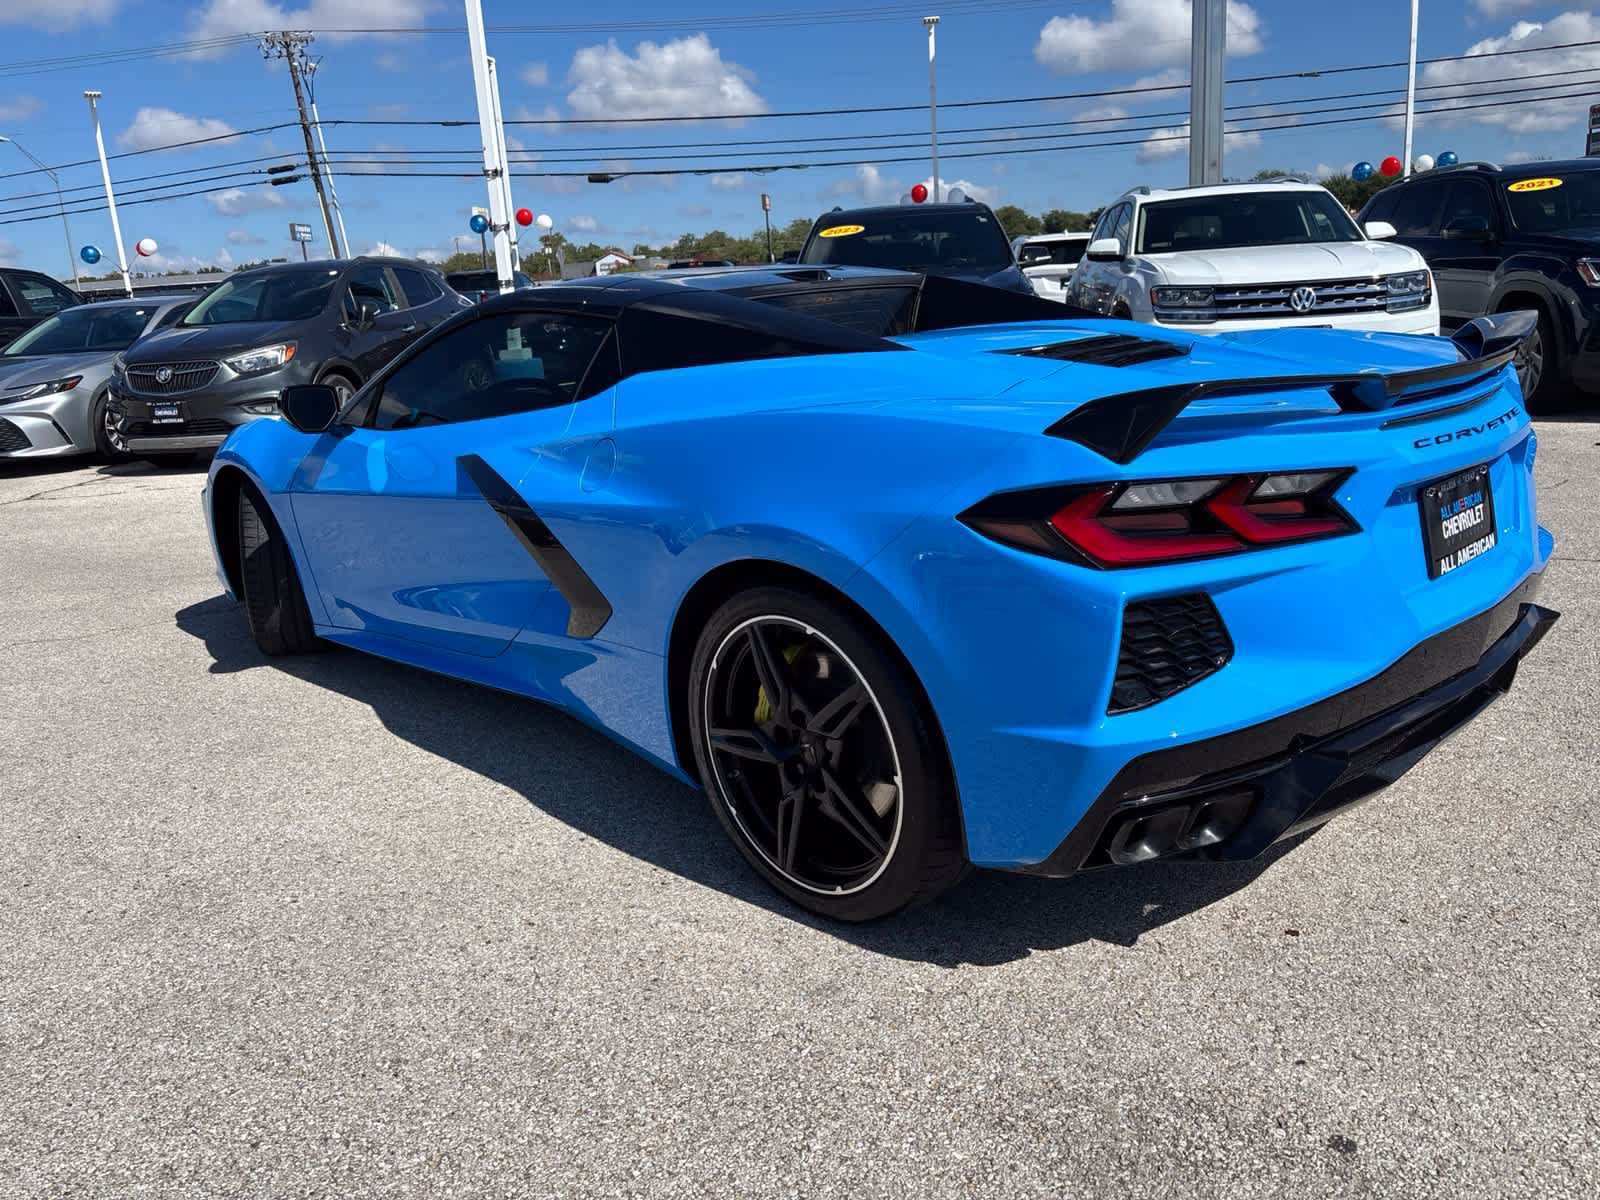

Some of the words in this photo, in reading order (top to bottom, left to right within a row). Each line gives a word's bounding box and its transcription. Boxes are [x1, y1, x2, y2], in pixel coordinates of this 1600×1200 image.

[1515, 179, 1554, 190] 2021
[1413, 407, 1521, 449] CORVETTE
[1440, 504, 1453, 521] ALL
[1453, 492, 1484, 514] AMERICAN
[1441, 503, 1484, 540] CHEVROLET
[1440, 556, 1457, 575] ALL
[1457, 532, 1495, 567] AMERICAN
